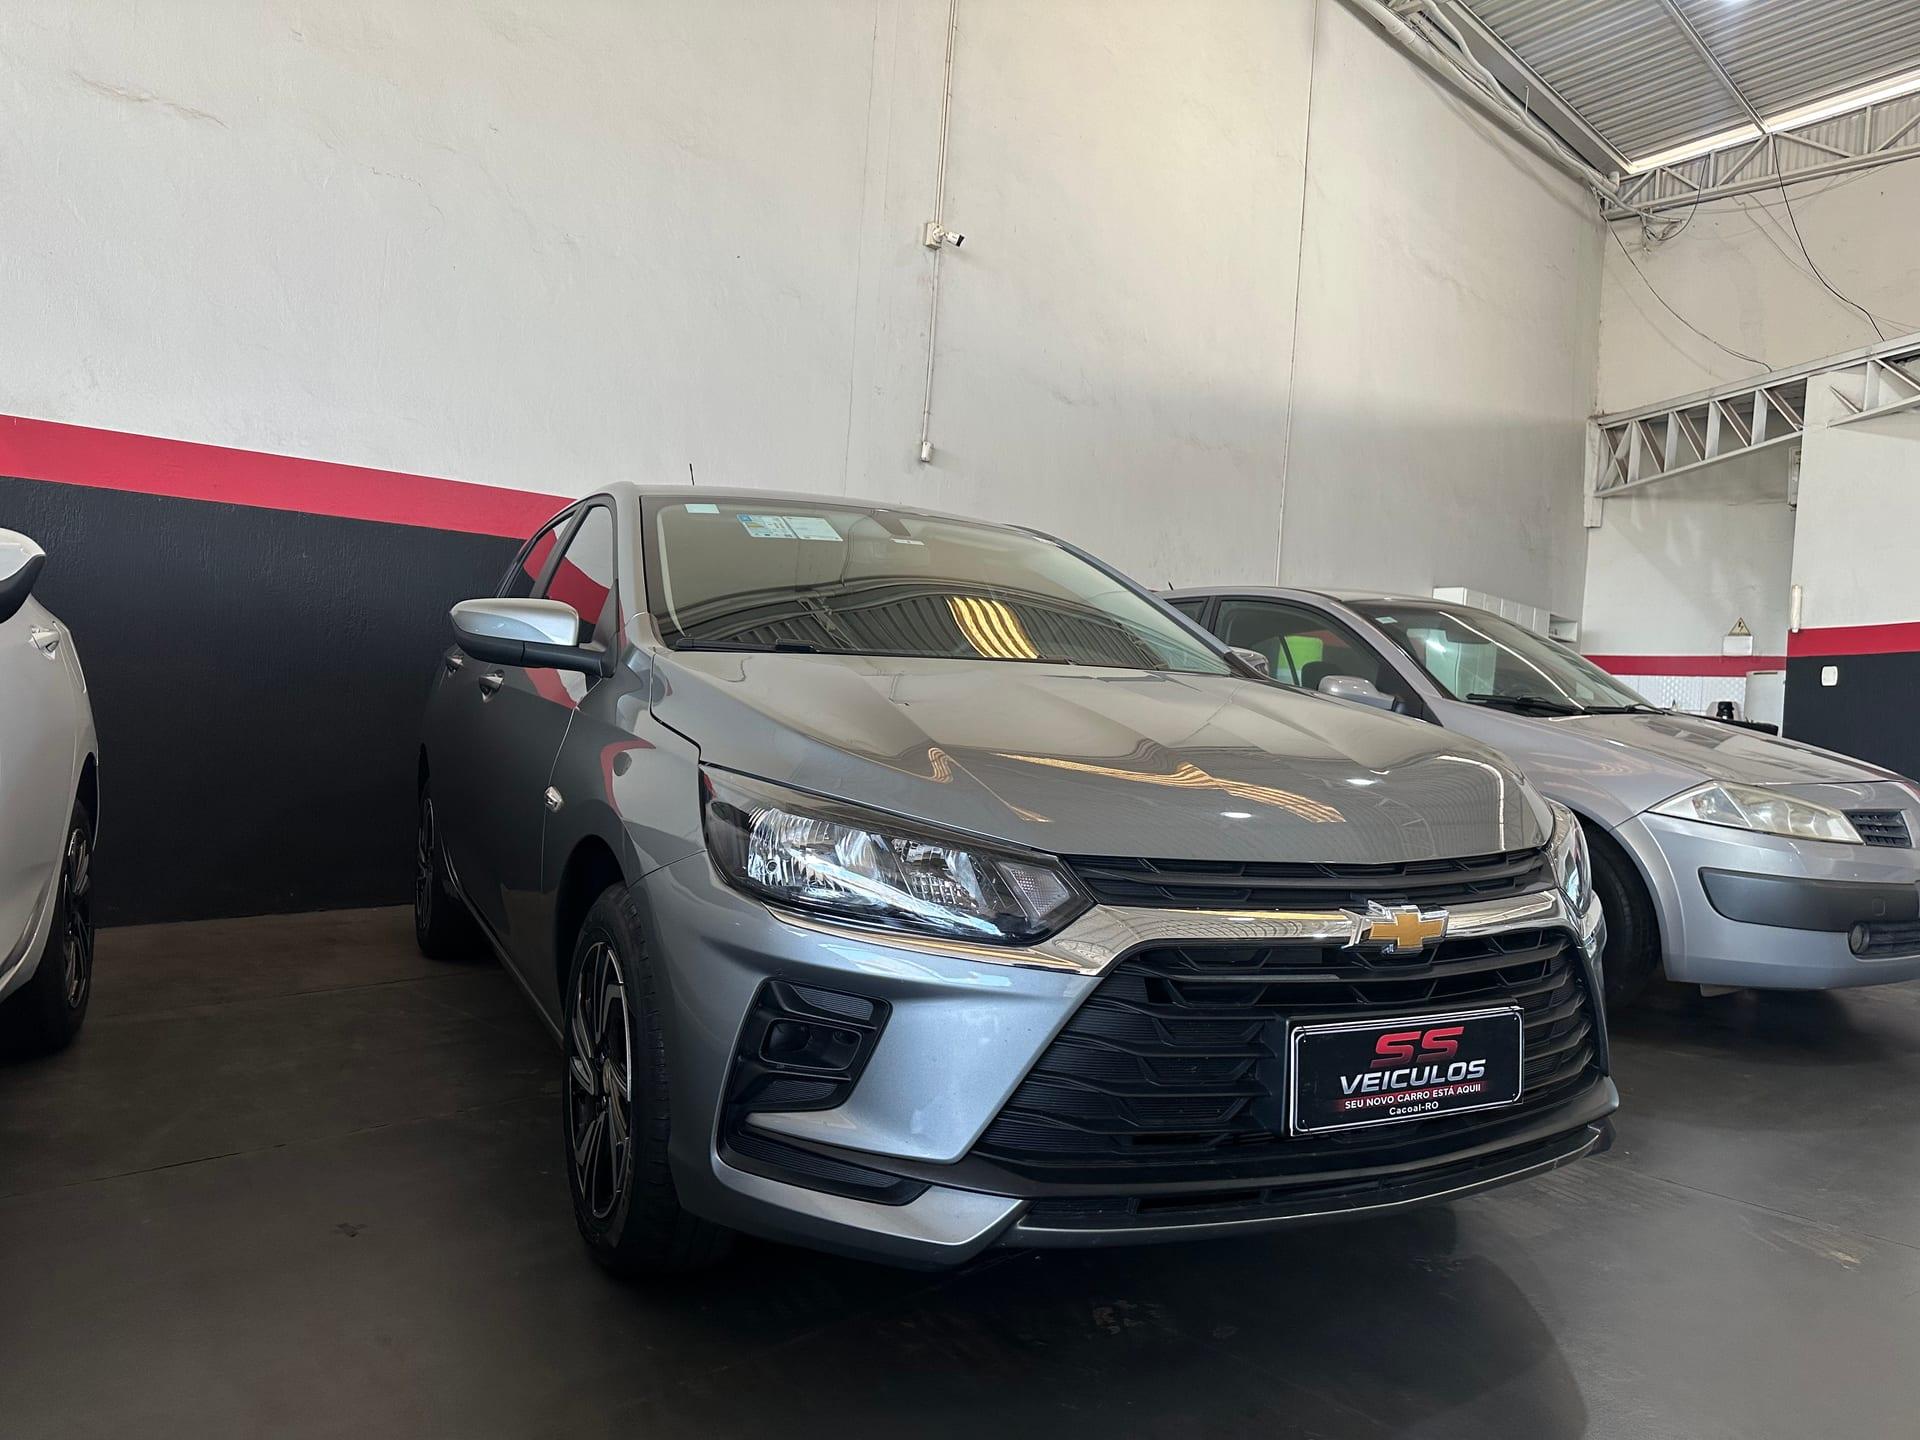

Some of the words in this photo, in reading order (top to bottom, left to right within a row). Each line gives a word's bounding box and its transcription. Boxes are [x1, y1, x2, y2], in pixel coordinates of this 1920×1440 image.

[1370, 1026, 1464, 1068] SS
[1340, 1059, 1486, 1095] VEICULOS
[1345, 1099, 1364, 1110] SEU
[1366, 1096, 1395, 1107] NOVO
[1397, 1090, 1430, 1103] CARRO
[1432, 1085, 1455, 1098] ESTÁ
[1389, 1101, 1439, 1116] Cacoal-RO
